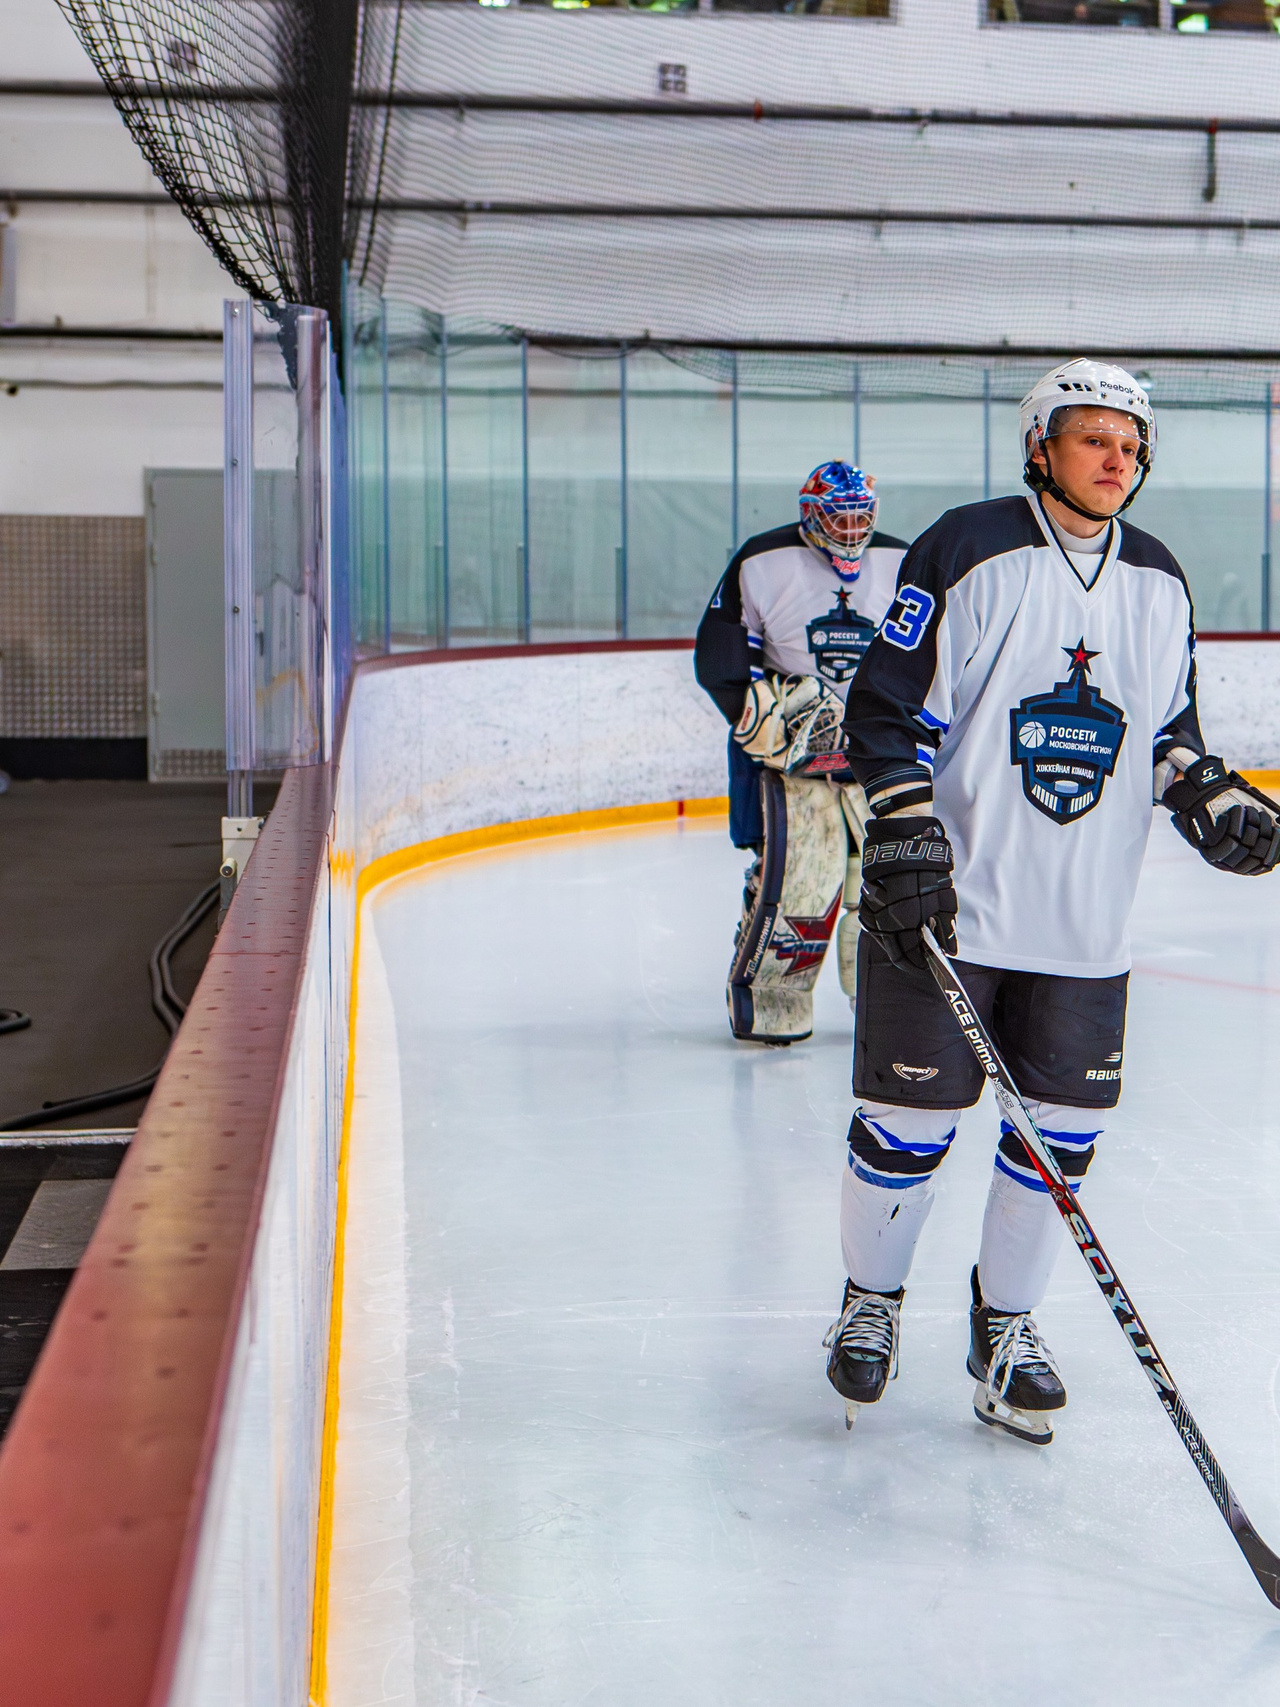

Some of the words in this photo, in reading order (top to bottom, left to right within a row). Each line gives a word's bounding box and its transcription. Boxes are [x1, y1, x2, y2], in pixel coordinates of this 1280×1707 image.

[1100, 381, 1135, 395] Reebok
[1050, 726, 1097, 742] РОССЕТИ
[1049, 740, 1089, 752] МОСКОВСКИЙ
[1090, 745, 1112, 755] РЕГИОН
[1036, 764, 1070, 774] ХОККЕЙНАЯ
[1071, 768, 1095, 779] КОМАНДА
[945, 990, 975, 1026] ACE
[965, 1029, 997, 1074] prime
[1063, 1212, 1174, 1394] SOYUZ
[1180, 1425, 1200, 1452] ACE
[1194, 1451, 1214, 1482] prime
